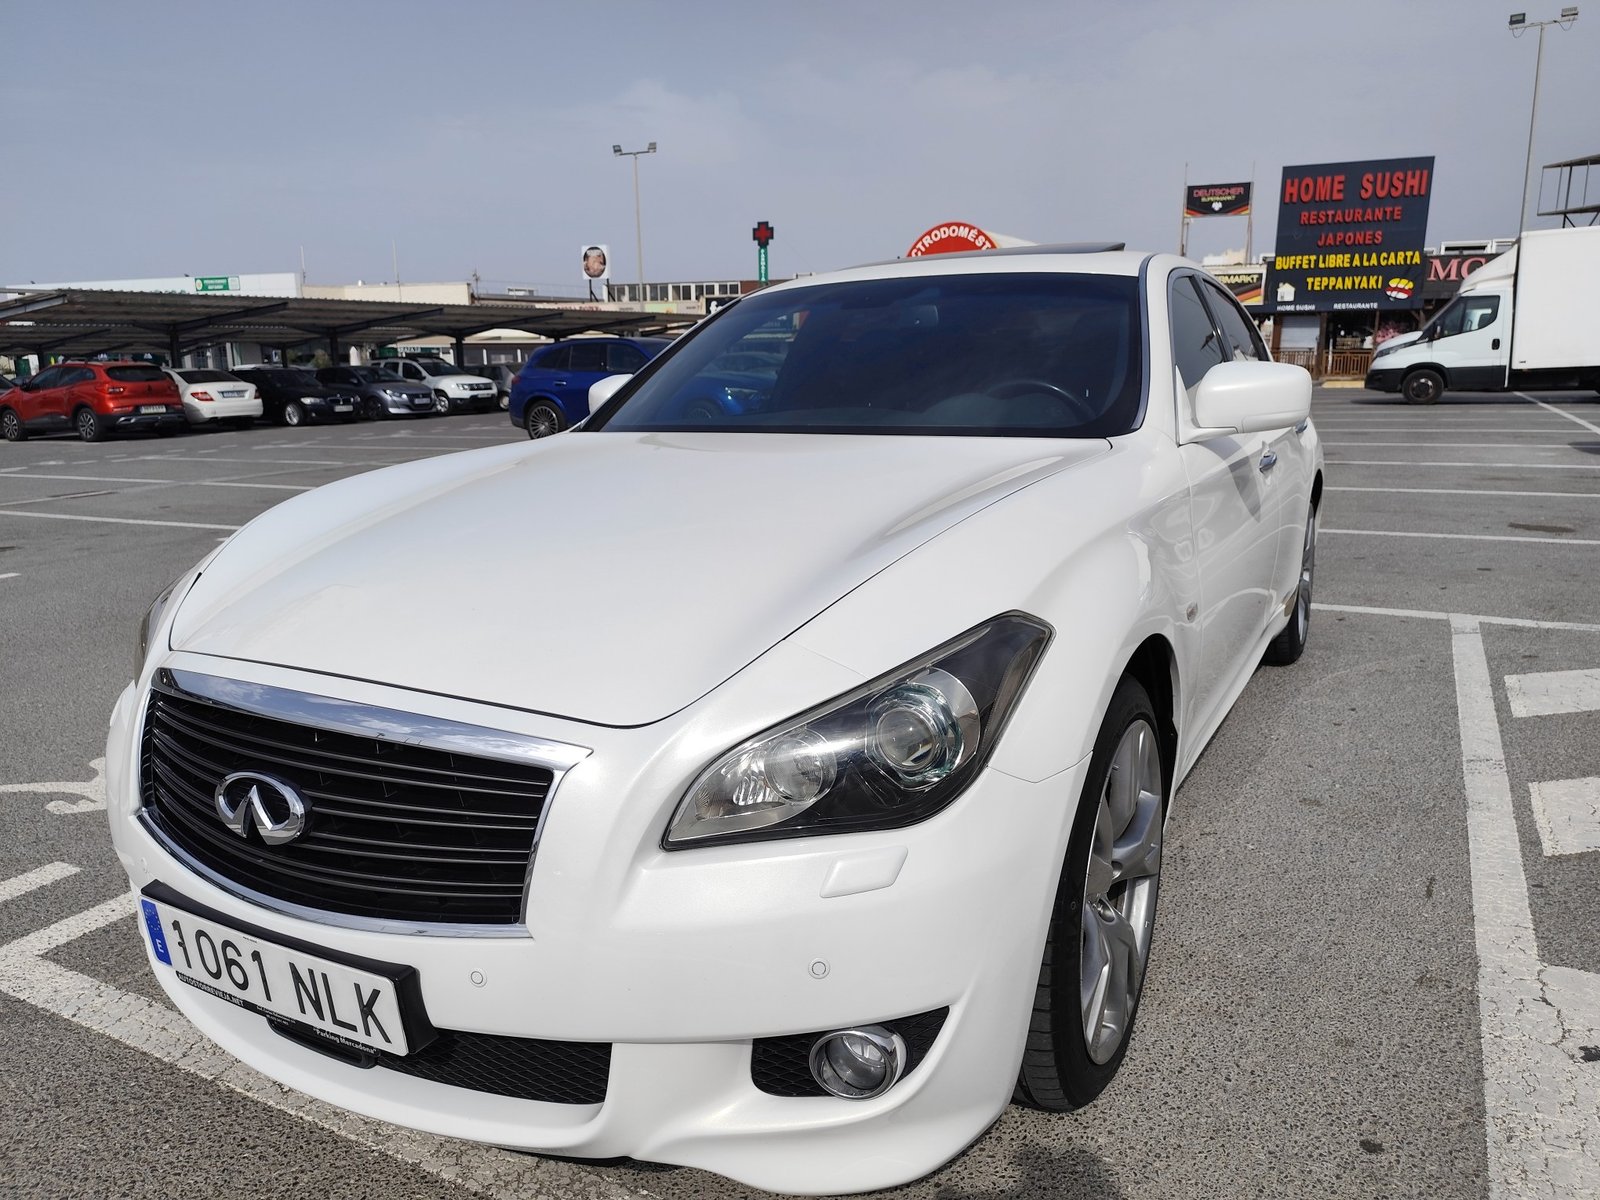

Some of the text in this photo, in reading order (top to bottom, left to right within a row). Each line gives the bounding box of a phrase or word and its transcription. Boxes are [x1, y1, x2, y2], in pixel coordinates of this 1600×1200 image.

[1284, 169, 1428, 203] HOME SUSHI
[1300, 207, 1402, 225] RESTAURANTE
[1317, 231, 1383, 246] JAPONES
[1275, 250, 1421, 270] BUFFET LIBRE A LA CARTA
[1306, 275, 1383, 290] TEPPANYAKI
[155, 938, 165, 953] E
[172, 920, 392, 1044] 1061 NLK
